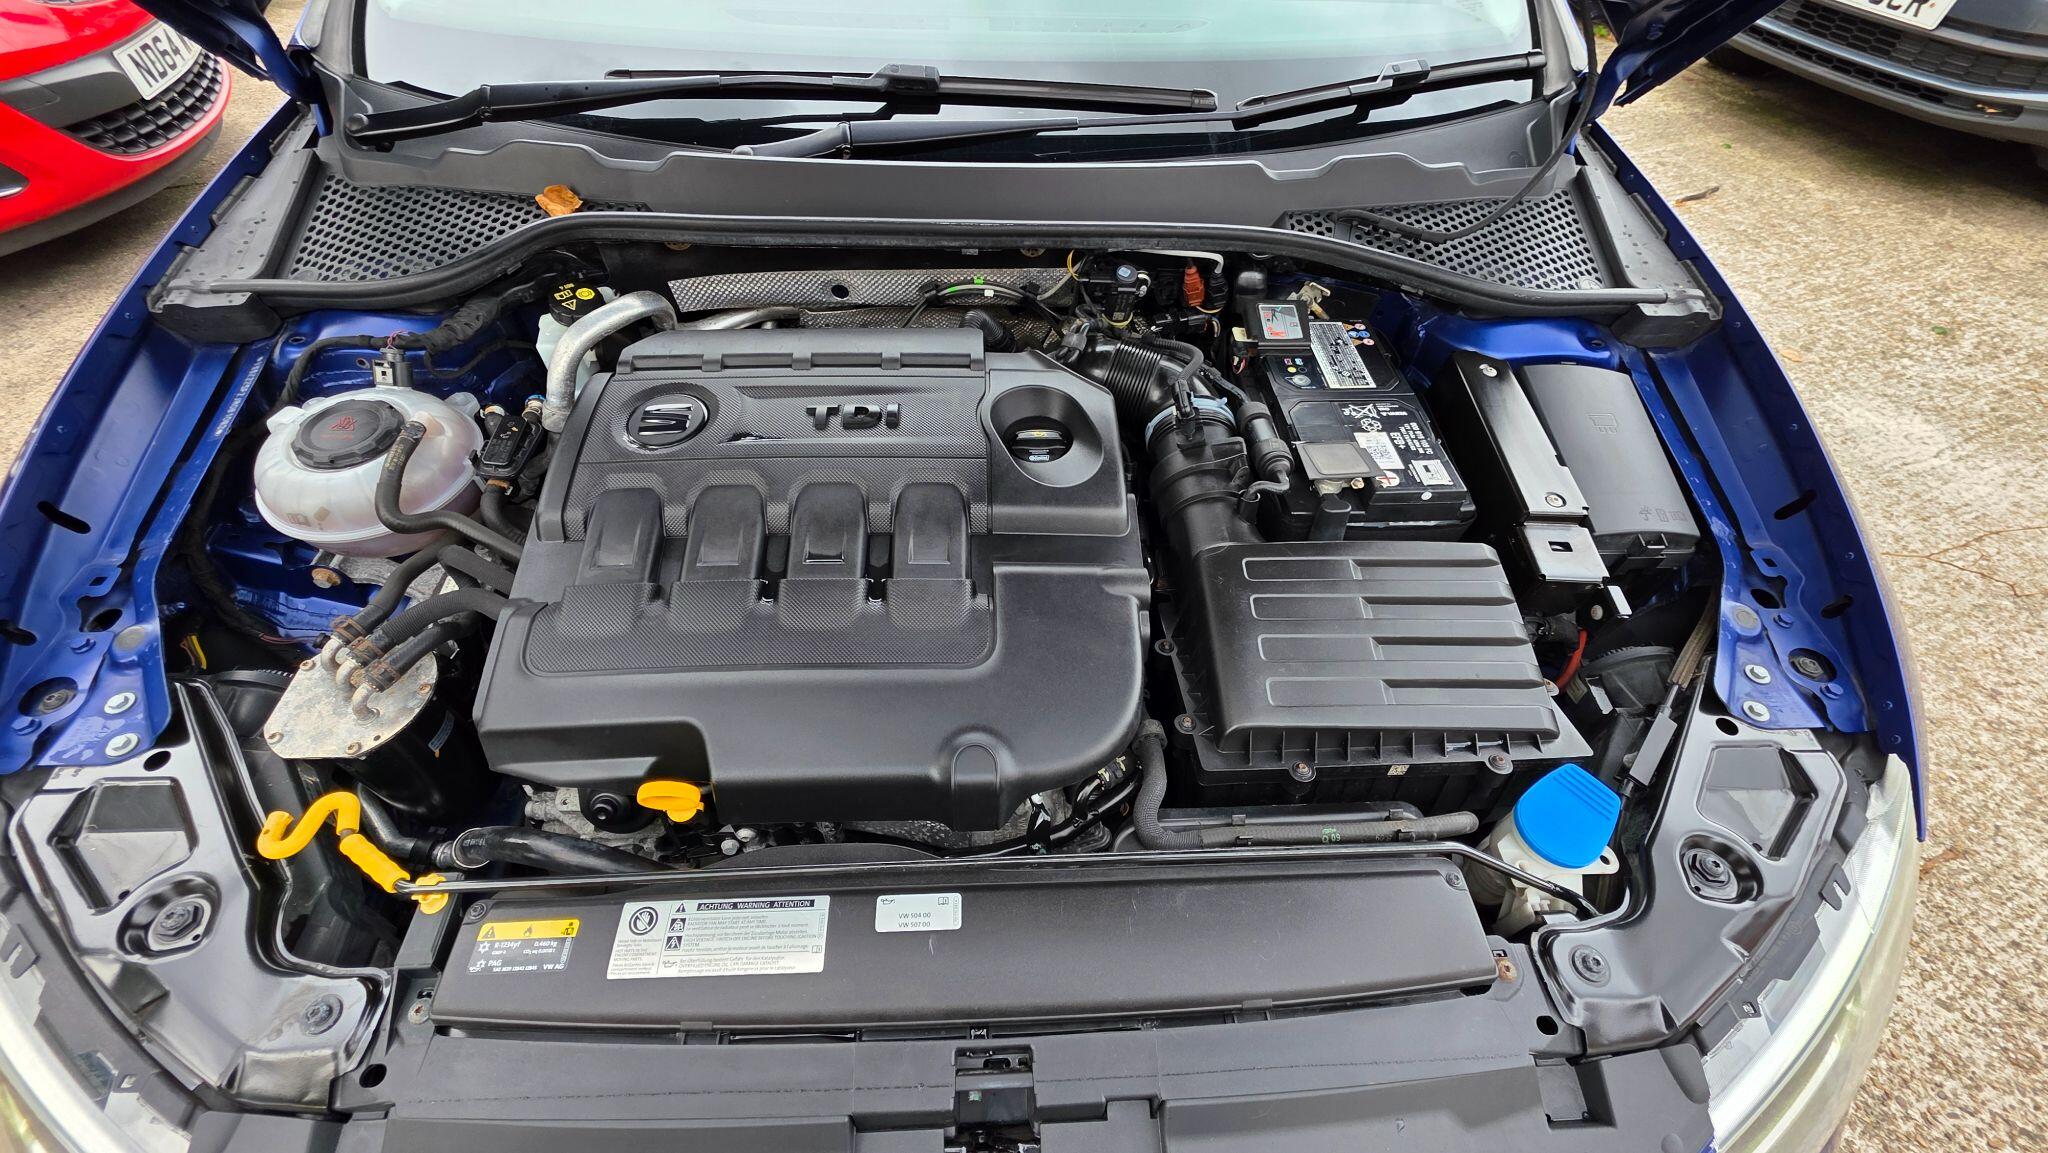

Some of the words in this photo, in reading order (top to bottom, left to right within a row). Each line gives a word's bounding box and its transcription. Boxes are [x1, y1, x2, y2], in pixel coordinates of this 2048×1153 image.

[127, 28, 187, 88] ND64
[1390, 432, 1406, 449] EFB+
[495, 941, 521, 949] R-1234yf
